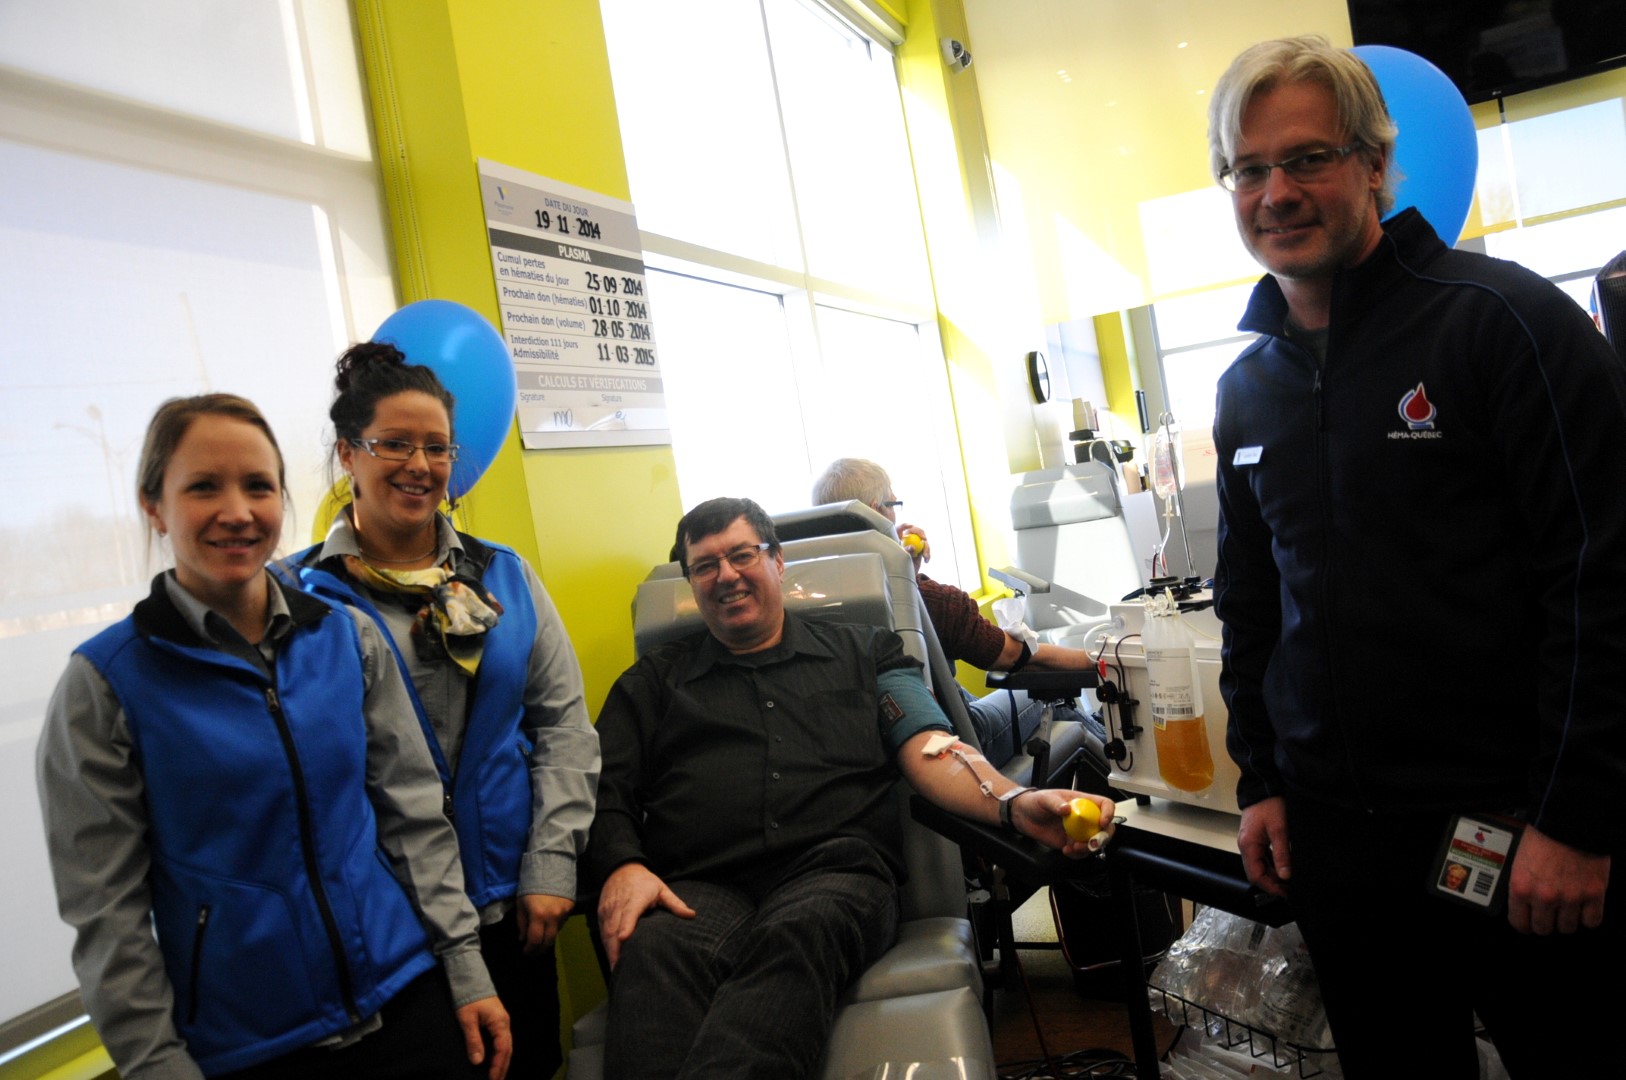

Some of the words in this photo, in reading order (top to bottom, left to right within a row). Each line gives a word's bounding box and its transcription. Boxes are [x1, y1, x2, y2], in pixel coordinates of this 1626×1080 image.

[545, 198, 561, 210] DATE
[563, 203, 572, 212] DU
[573, 205, 589, 216] JOUR
[497, 252, 521, 264] Cumul
[523, 257, 546, 269] pertes
[558, 245, 592, 262] PLASMA
[500, 268, 510, 276] en
[511, 267, 544, 282] hématies
[545, 273, 555, 283] du
[555, 275, 570, 286] jour
[503, 287, 536, 300] Prochain
[537, 291, 550, 303] don
[552, 292, 588, 309] (hématies)
[507, 312, 540, 324] Prochain
[542, 315, 555, 326] don
[556, 314, 586, 331] (volume)
[510, 335, 549, 346] Interdiction
[550, 338, 562, 347] 111
[563, 340, 579, 349] jours
[513, 348, 560, 360] Admissibilité
[538, 375, 577, 388] CALCULS
[578, 376, 589, 388] ET
[589, 375, 647, 391] VÉRIFICATIONS
[520, 392, 545, 403] Signature
[601, 394, 622, 403] Signature
